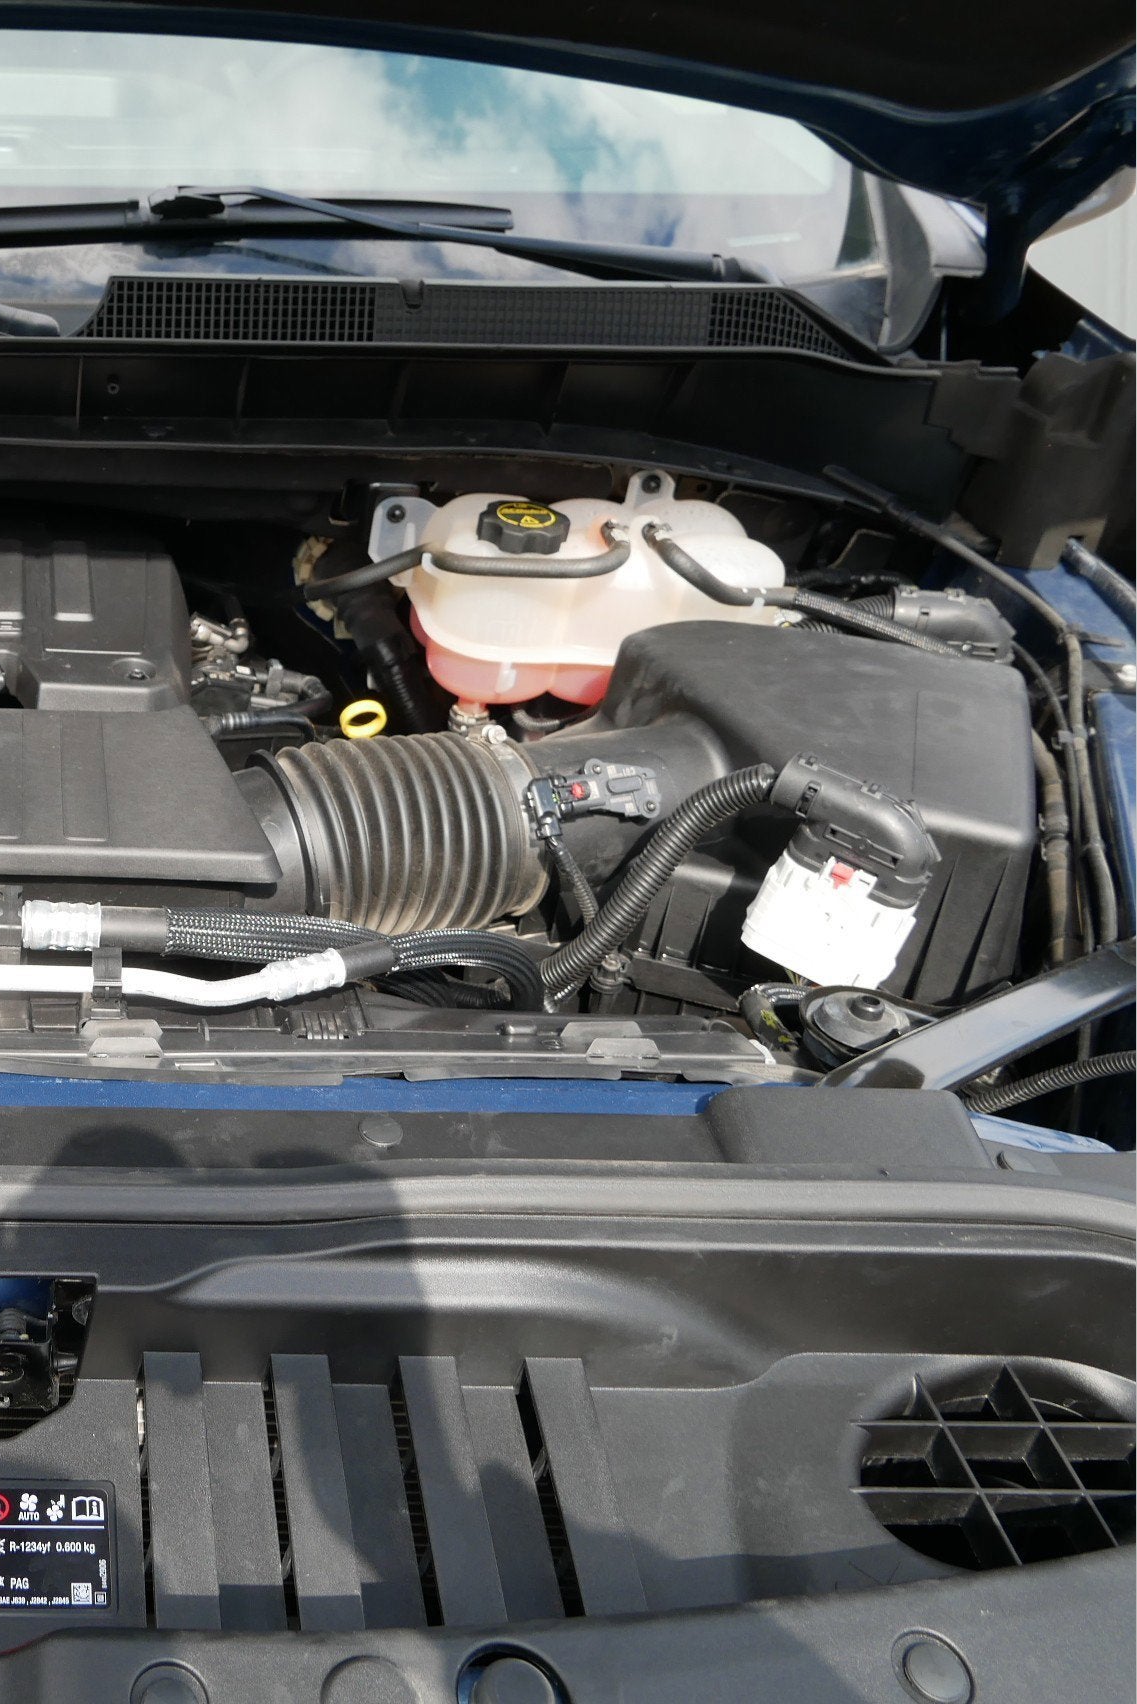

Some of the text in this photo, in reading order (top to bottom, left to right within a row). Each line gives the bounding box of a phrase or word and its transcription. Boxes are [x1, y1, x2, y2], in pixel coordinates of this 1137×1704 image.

[18, 1512, 39, 1521] AUTO
[9, 1541, 96, 1554] R-1234yf 0.600 kg
[10, 1577, 29, 1590] PAG
